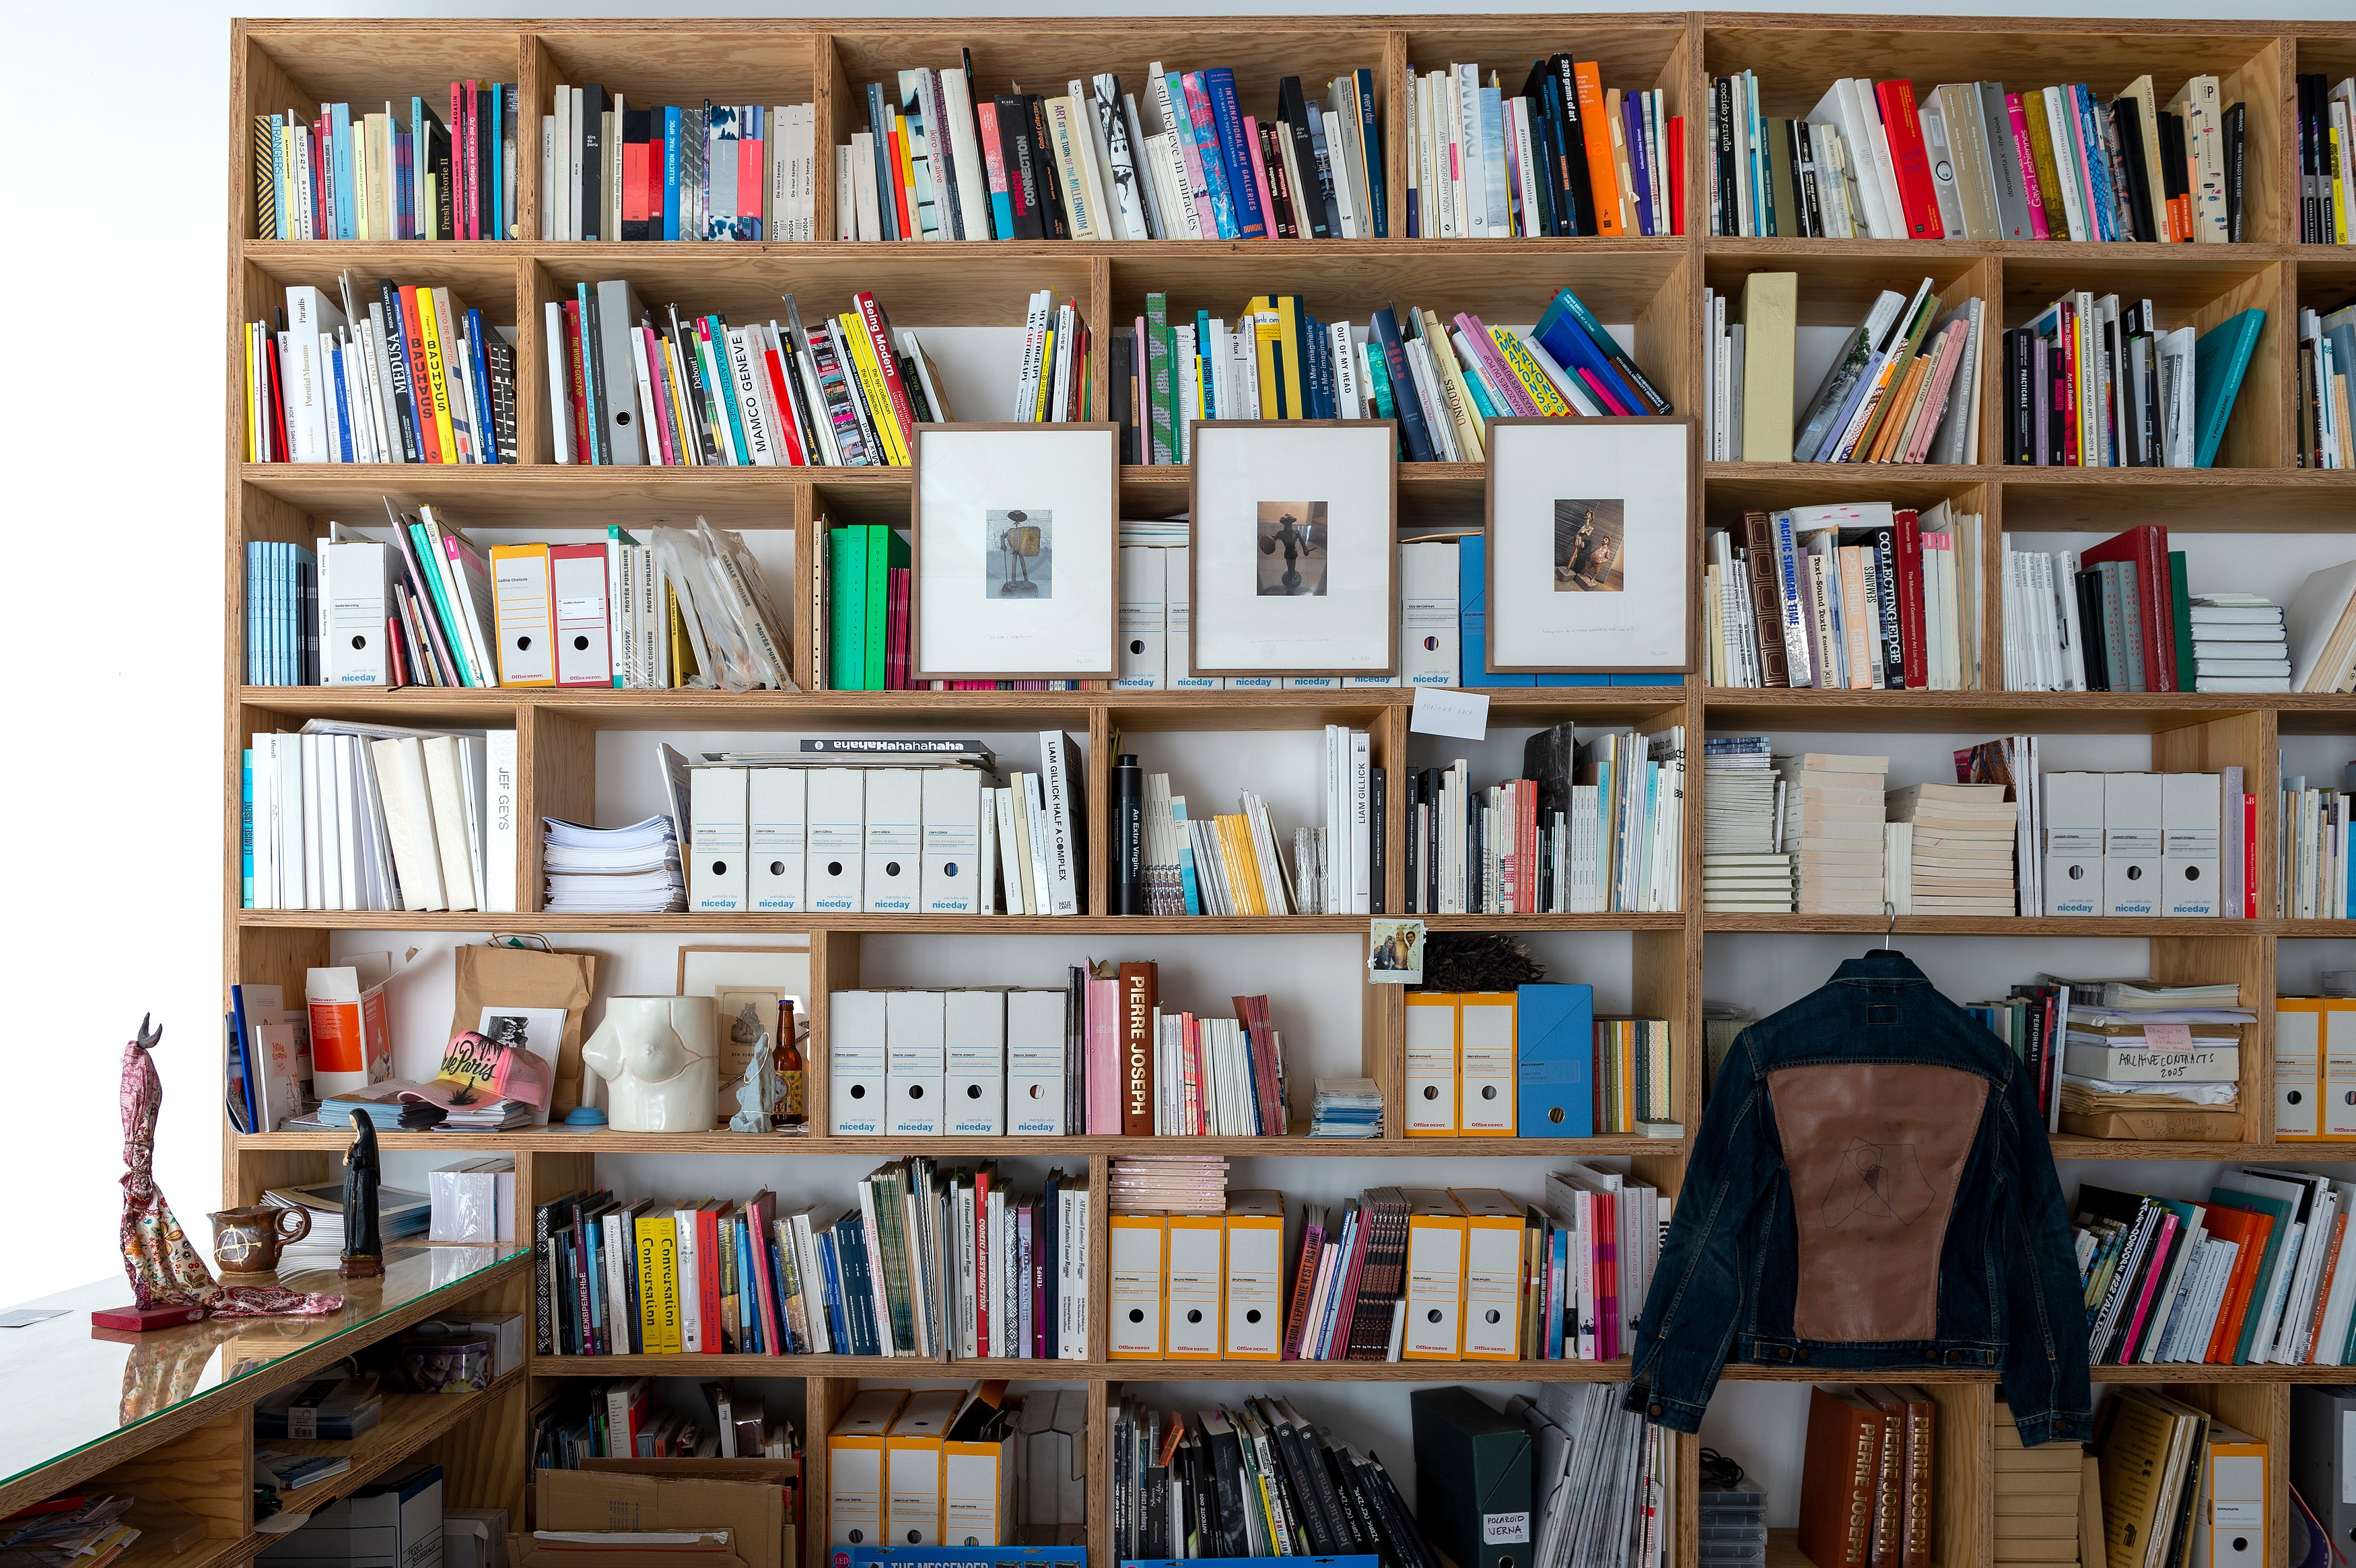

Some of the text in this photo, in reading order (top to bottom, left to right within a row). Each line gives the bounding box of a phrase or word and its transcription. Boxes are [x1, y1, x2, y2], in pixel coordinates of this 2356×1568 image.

[1561, 59, 1569, 77] 2870
[1156, 85, 1169, 105] still
[1564, 78, 1574, 100] grams
[1032, 102, 1043, 129] Collectors
[1054, 105, 1066, 120] ART
[1461, 65, 1473, 158] DYNAMO
[271, 118, 283, 174] STRANGERS
[1060, 129, 1068, 141] THE
[1163, 112, 1179, 155] believe
[1722, 124, 1731, 151] crudo
[1062, 142, 1071, 157] TURN
[1064, 157, 1072, 166] OF
[1225, 87, 1256, 211] INTERNATIONAL ART GALLERIES
[2021, 130, 2036, 178] Lesbiennes
[1016, 136, 1035, 207] CONNECTION
[1066, 167, 1074, 178] THE
[1176, 160, 1183, 172] in
[1441, 144, 1449, 194] PHOTOGRAPHY
[441, 168, 449, 204] Théorie
[1011, 171, 1027, 216] FRENCH
[1267, 167, 1277, 197] Multitudes
[2032, 184, 2041, 207] Gays
[442, 207, 450, 231] Fresh
[1069, 179, 1087, 229] MILLENNIUM
[1179, 178, 1197, 231] miracles
[1243, 223, 1263, 234] DUMONT
[864, 300, 895, 378] Being Modern
[1021, 312, 1037, 383] MY CARTOGRAPHY
[389, 332, 407, 394] MEDUSA
[689, 357, 702, 390] Debout!
[712, 326, 724, 361] BARBARA
[726, 394, 737, 423] STAGES
[1337, 327, 1351, 394] OUT OF MY HEAD
[1495, 329, 1545, 404] AMAZONS
[411, 338, 432, 418] BAUHAUS
[427, 341, 445, 411] BAUHAUS
[1202, 357, 1214, 409] ABSENT MUSEUM
[732, 336, 766, 452] MAMCO GENEVE
[1444, 380, 1466, 427] UNIQUES
[2054, 379, 2063, 411] INCOGNITO
[862, 423, 872, 444] Feed
[1779, 518, 1799, 626] PACIFIC STANDARD TIME
[1867, 565, 1877, 603] SEMAINES
[1879, 532, 1902, 664] COLLECTING EDGE
[342, 673, 376, 682] niceday
[1119, 678, 1154, 688] niceday
[1177, 678, 1213, 687] niceday
[1414, 675, 1449, 684] niceday
[1422, 703, 1451, 713] ADRIANA
[1047, 742, 1057, 762] LIAM
[1049, 764, 1061, 801] GILLICK
[1357, 763, 1366, 824] LIAM GILLICK
[499, 767, 509, 830] JEF GEYS
[1053, 804, 1063, 826] HALF
[1132, 809, 1139, 822] An
[245, 846, 252, 855] LE
[1054, 837, 1066, 881] COMPLEX
[701, 899, 736, 908] niceday
[932, 900, 968, 910] niceday
[2057, 904, 2093, 913] niceday
[2174, 905, 2209, 913] niceday
[452, 1040, 495, 1081] Paris
[1130, 976, 1146, 1115] PIERRE JOSEPH
[2031, 1053, 2038, 1062] 11
[2119, 1053, 2215, 1069] ARCHIVE CONTRACTS
[2161, 1066, 2188, 1078] 2005
[839, 1123, 875, 1131] niceday
[1309, 1232, 1319, 1250] FINIE
[2119, 1198, 2151, 1272] KALEIDOSCOPE
[1304, 1250, 1315, 1266] PAS
[642, 1238, 657, 1326] Conversation
[660, 1238, 675, 1326] Conversation
[979, 1250, 987, 1312] ABSTRACTION
[1301, 1267, 1313, 1285] N'EST
[2109, 1273, 2121, 1294] #22
[580, 1271, 591, 1337] МЕЖВРЕМЕНЬЕ
[1286, 1326, 1301, 1354] VIH/SIDA
[1296, 1470, 1328, 1544] Jean-Luc Verna
[1846, 1423, 1875, 1562] PIERRE JOSEPH
[1487, 1516, 1525, 1524] POLAROÏD
[1488, 1525, 1522, 1536] VERNA
[409, 1542, 423, 1556] FEDEX
